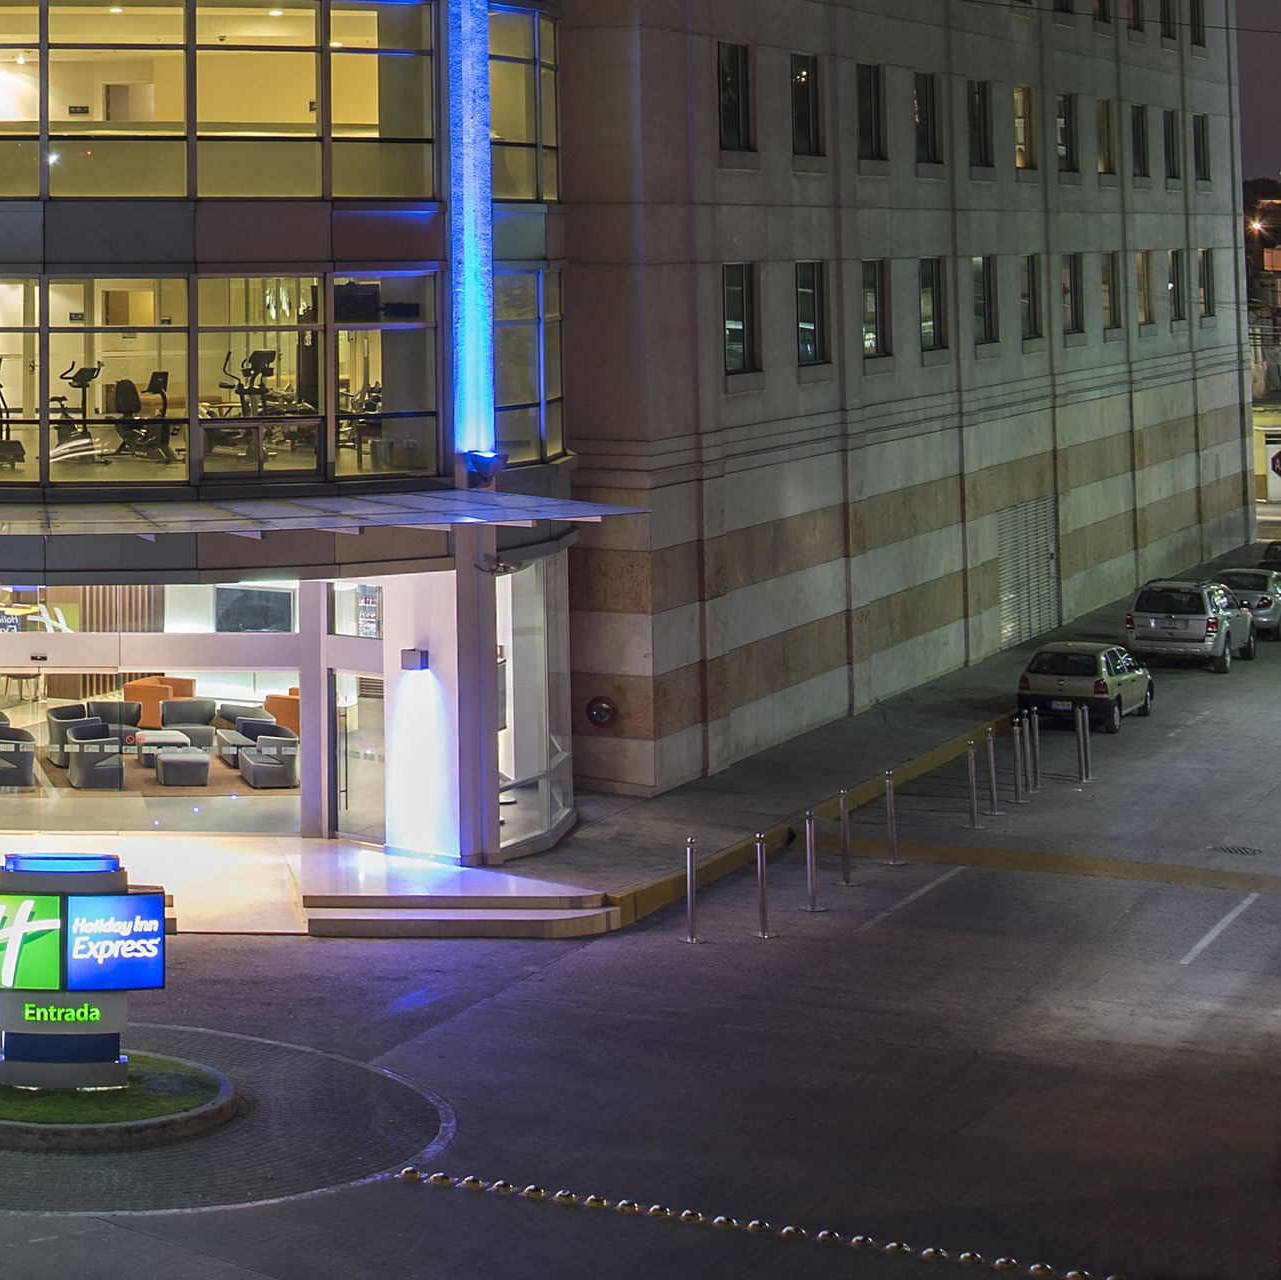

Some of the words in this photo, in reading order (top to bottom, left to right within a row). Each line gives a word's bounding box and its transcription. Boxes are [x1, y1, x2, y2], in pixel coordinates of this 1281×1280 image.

[72, 917, 133, 937] Holiday
[133, 915, 159, 932] Inn
[72, 937, 159, 963] Express
[23, 1003, 101, 1022] Entrada
